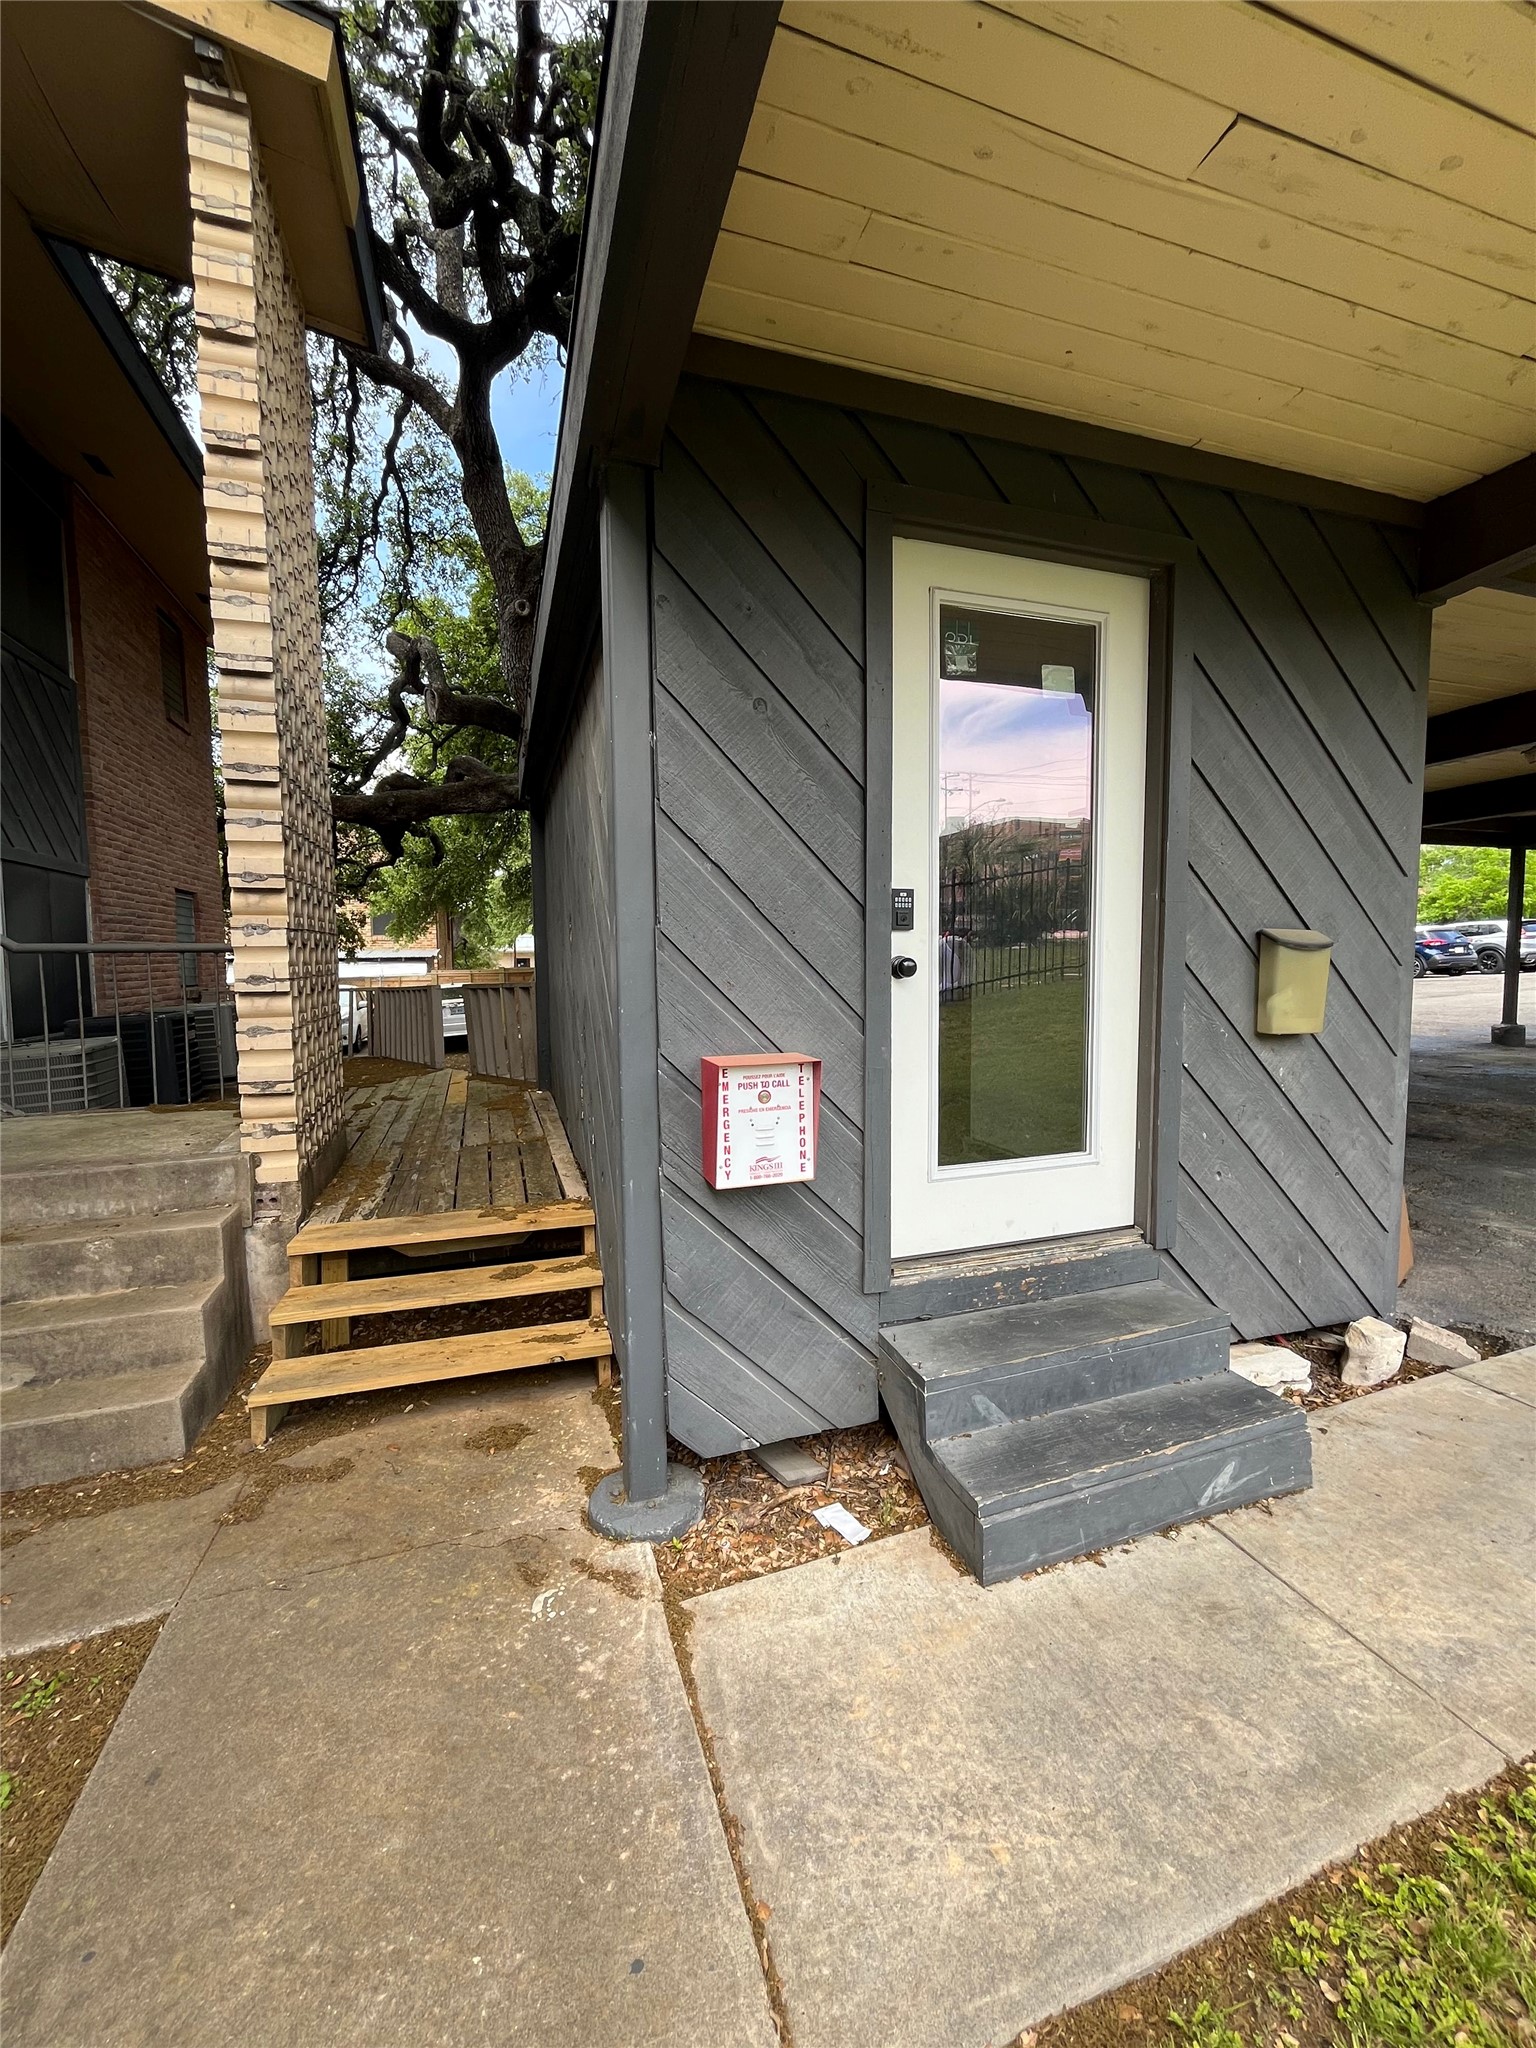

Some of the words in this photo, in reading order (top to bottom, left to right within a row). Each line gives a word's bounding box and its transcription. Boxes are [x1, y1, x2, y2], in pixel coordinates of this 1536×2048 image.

[721, 1068, 732, 1180] EMERGENCY
[737, 1081, 758, 1091] PUSH
[760, 1080, 770, 1089] TO
[771, 1079, 790, 1088] CALL
[798, 1063, 806, 1172] TELEPHONE
